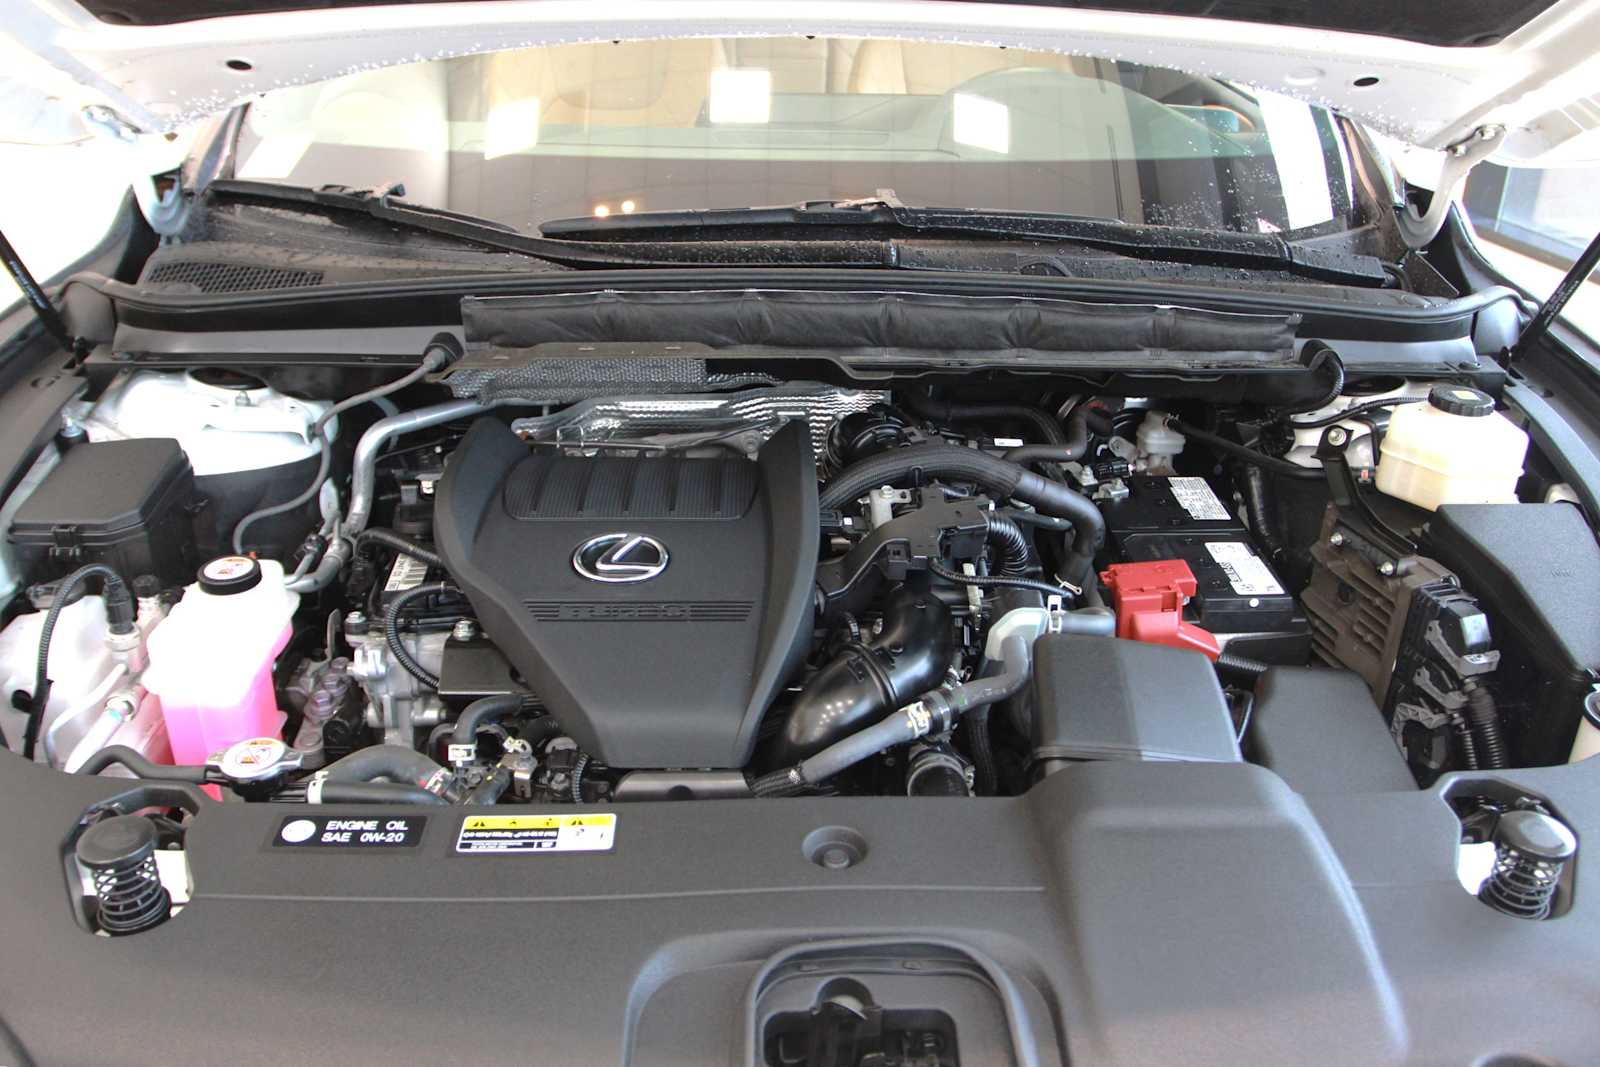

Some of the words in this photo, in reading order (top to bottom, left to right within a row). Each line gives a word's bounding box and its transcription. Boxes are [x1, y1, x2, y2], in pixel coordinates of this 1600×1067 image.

[325, 820, 379, 831] ENGINE
[385, 820, 409, 831] OIL
[321, 832, 352, 843] SAE
[360, 832, 405, 843] 0W-20
